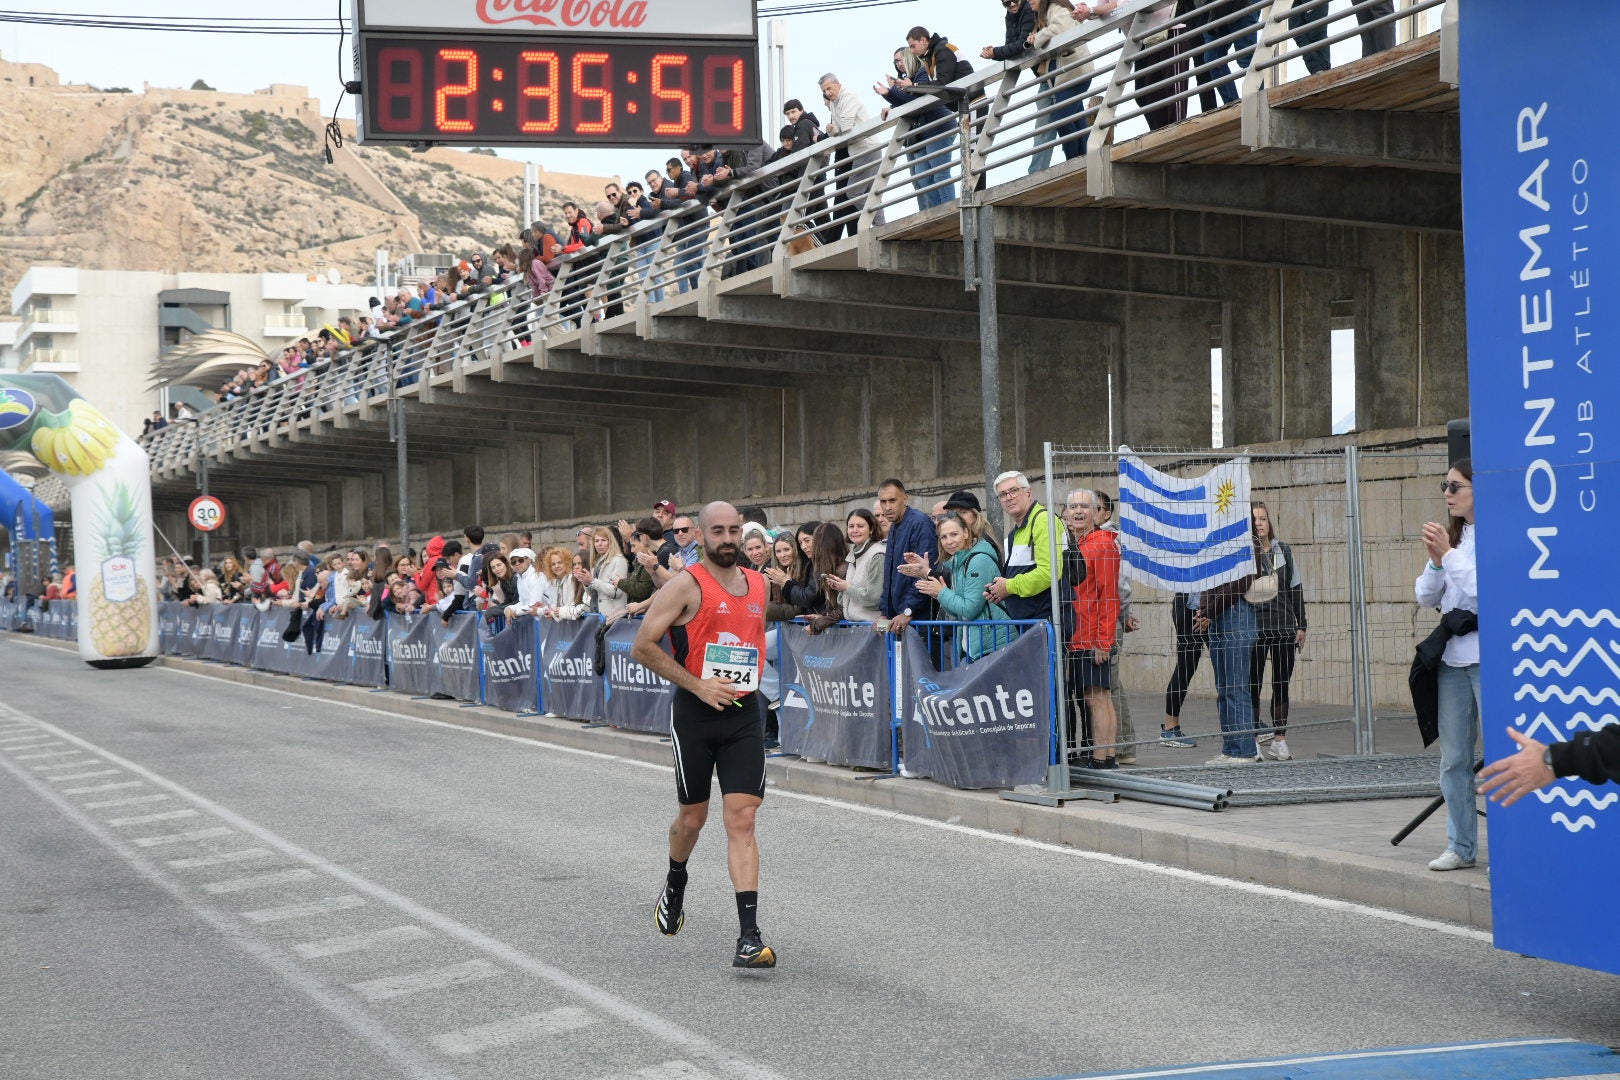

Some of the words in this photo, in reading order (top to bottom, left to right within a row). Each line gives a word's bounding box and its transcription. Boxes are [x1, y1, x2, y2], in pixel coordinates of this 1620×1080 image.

[1569, 158, 1592, 374] ATLÉTICO
[1517, 101, 1560, 579] MONTEMAR
[1577, 400, 1596, 512] CLUB
[197, 508, 217, 519] 30
[611, 654, 671, 685] Alican
[712, 668, 751, 684] 3324
[807, 671, 875, 708] Alicante
